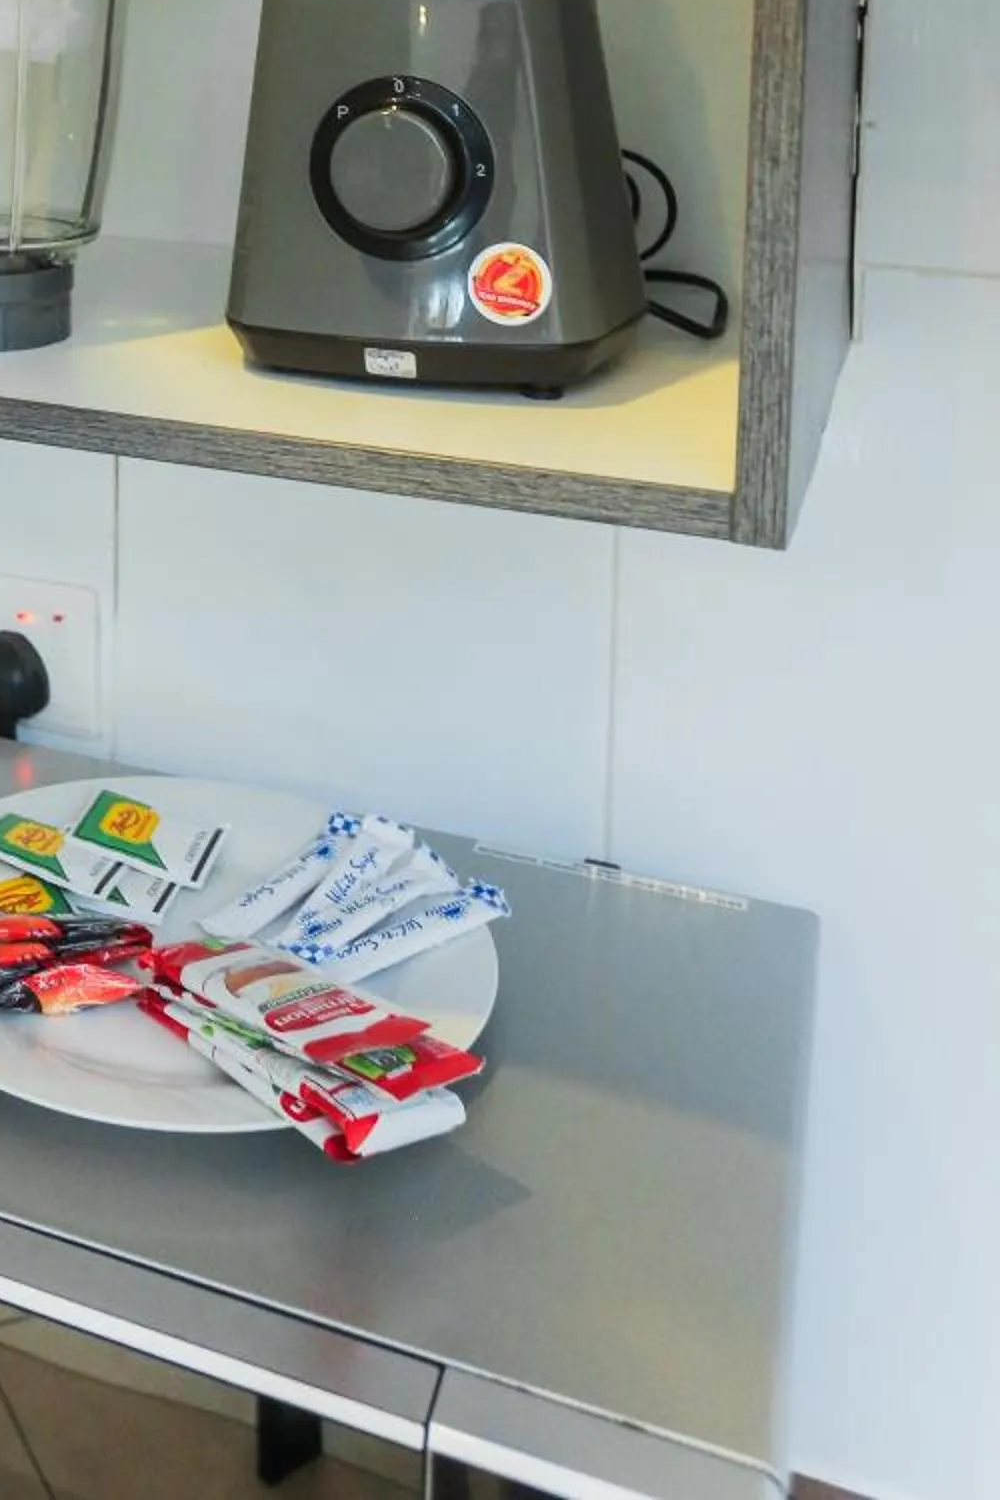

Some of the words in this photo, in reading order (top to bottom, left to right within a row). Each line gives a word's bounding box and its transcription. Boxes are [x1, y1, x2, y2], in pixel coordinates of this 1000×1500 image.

[337, 105, 350, 119] P
[452, 103, 460, 117] 1
[475, 163, 486, 177] 2
